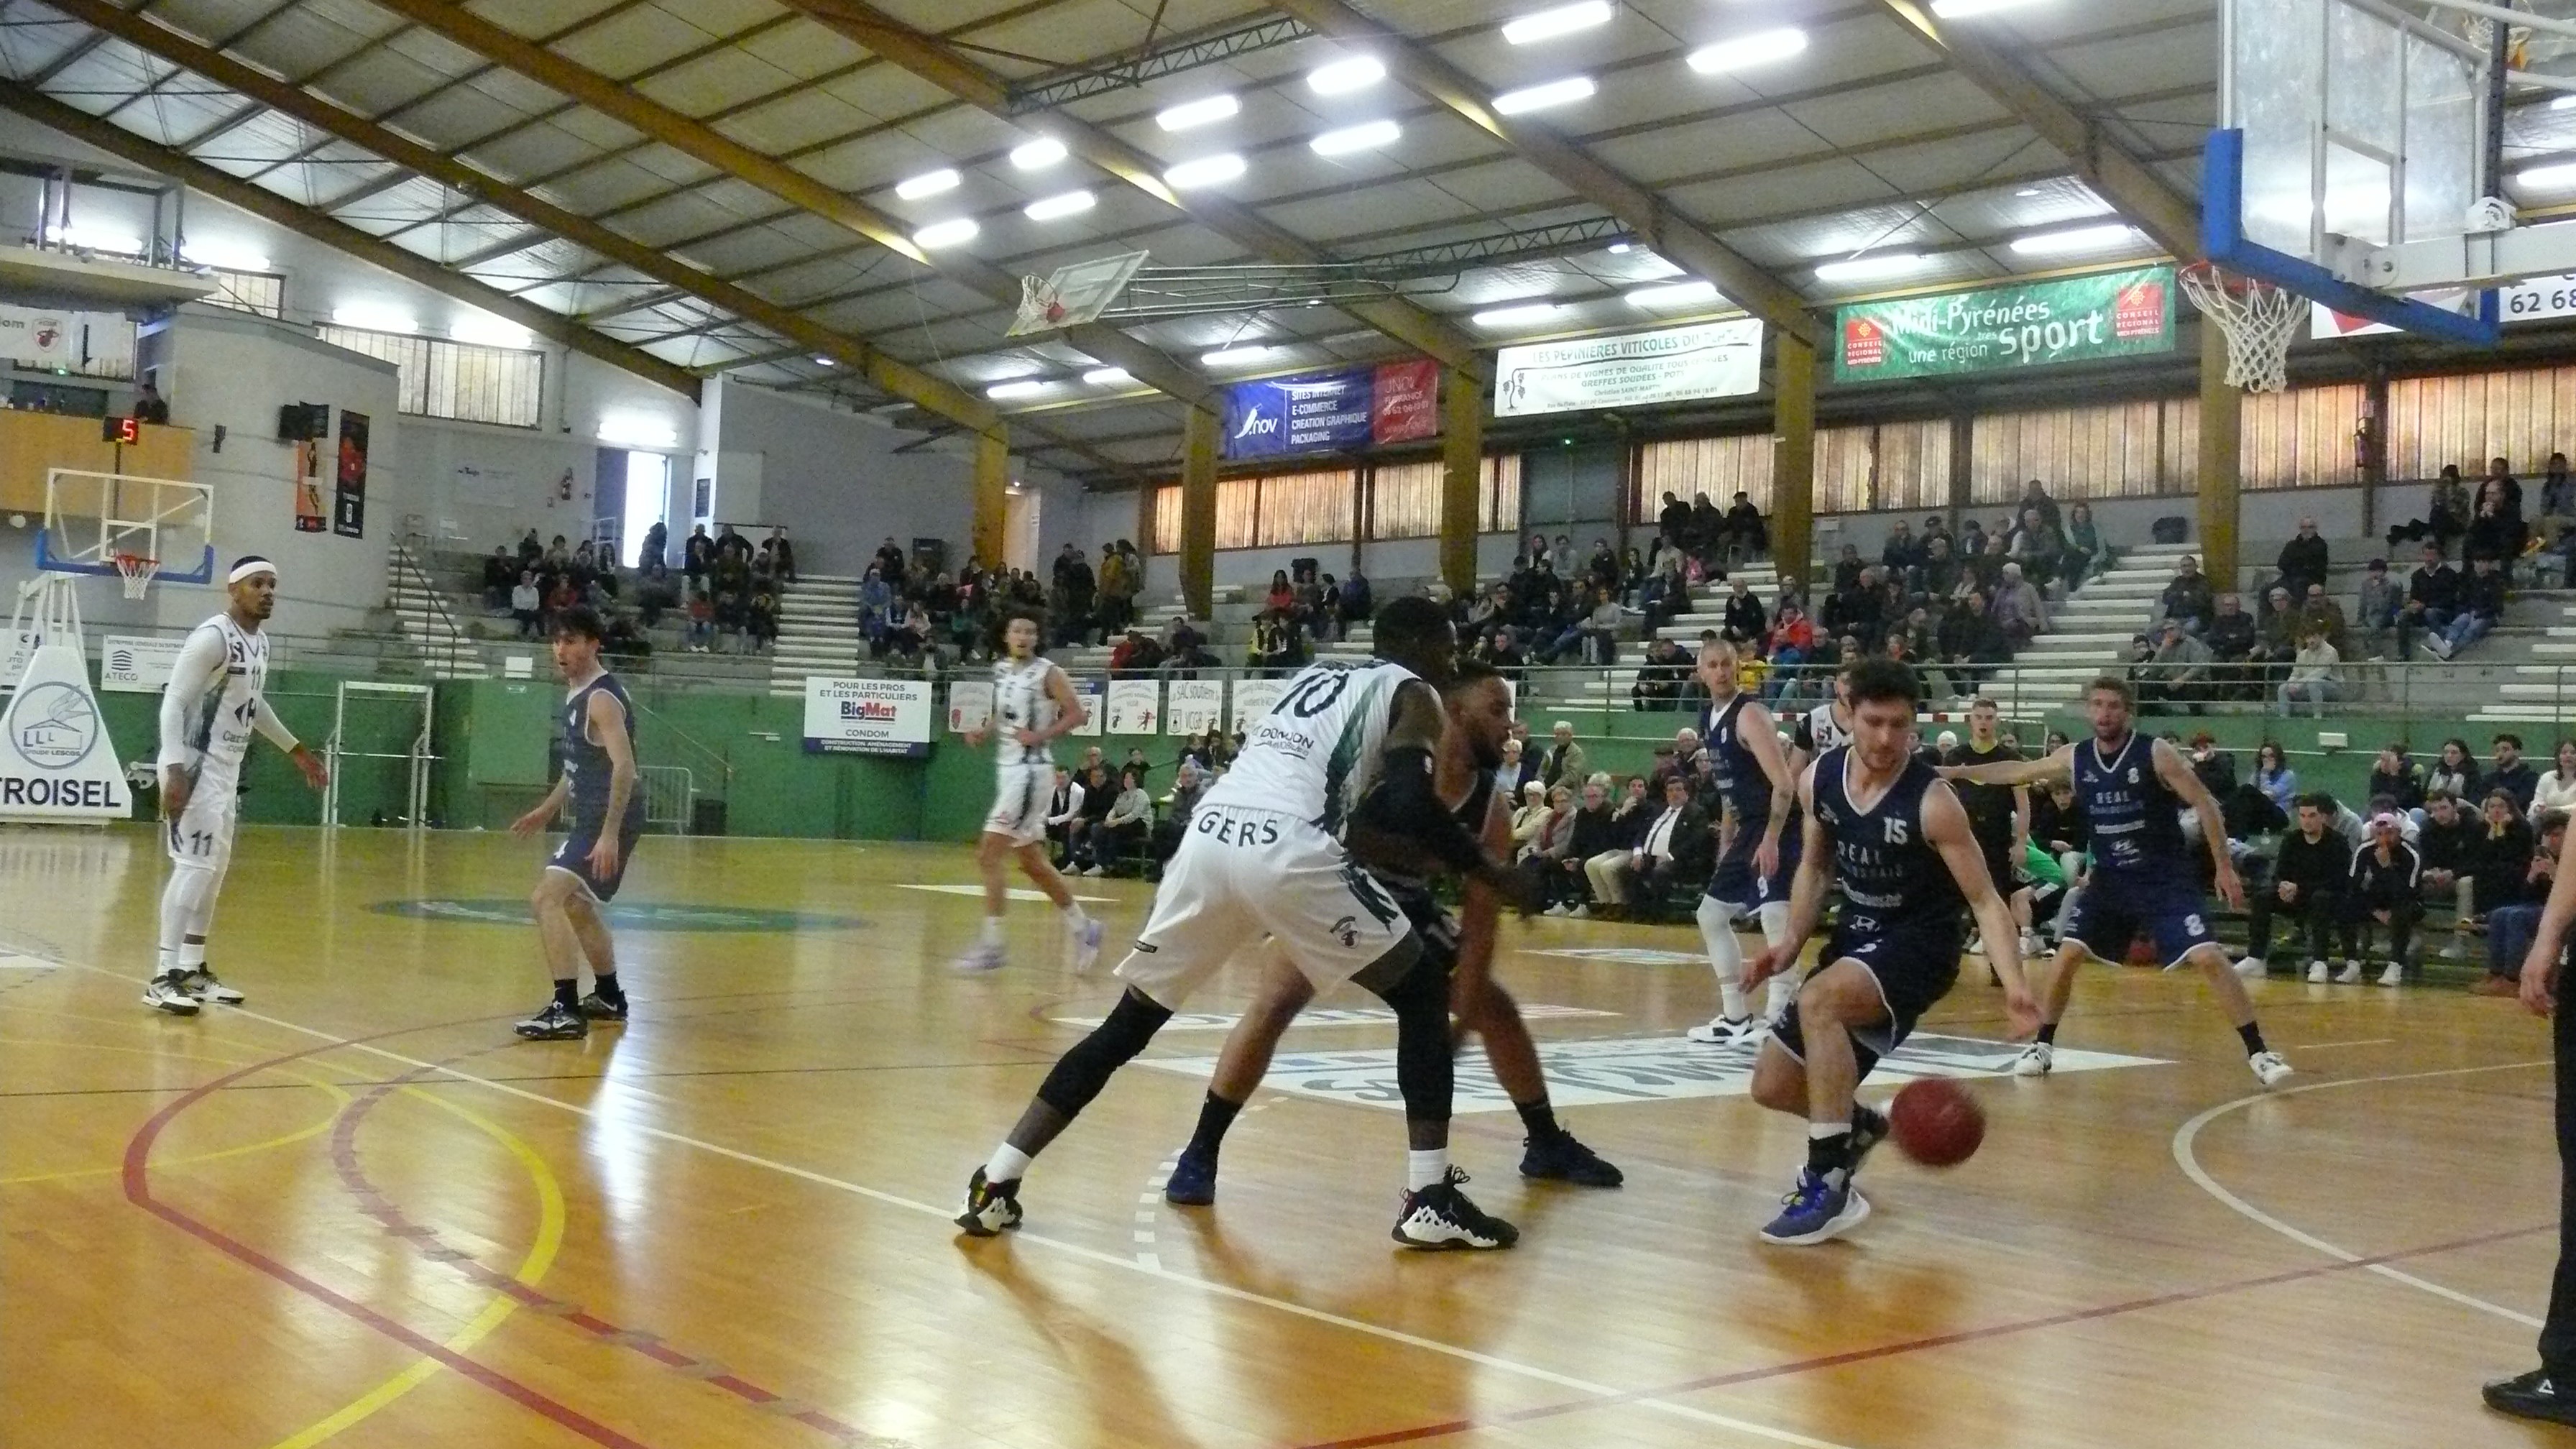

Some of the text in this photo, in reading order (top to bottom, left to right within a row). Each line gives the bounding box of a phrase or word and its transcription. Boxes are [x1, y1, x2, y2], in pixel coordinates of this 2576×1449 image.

[2511, 288, 2576, 313] 62 68
[1892, 295, 2051, 335] Midi-Pyrénées
[2117, 310, 2158, 319] CONSEIL
[1621, 337, 1678, 354] VITICOLES
[1847, 341, 1882, 349] CONSEIL
[1999, 310, 2104, 363] sport
[1909, 341, 1987, 363] une région
[1581, 377, 1619, 387] GREFFES
[1584, 369, 1613, 378] VIGNES
[1292, 390, 1311, 400] SITES
[1292, 400, 1338, 415] E-COMMERCE
[122, 419, 134, 440] 5
[1292, 412, 1367, 430] CREATION GRAPHIQUE
[1291, 431, 1330, 444] PACKAGING
[105, 672, 138, 681] ATECO
[852, 691, 917, 701] PARTICULIERS
[1271, 672, 1349, 717] 10
[841, 701, 897, 719] BigMat
[845, 729, 889, 738] CONDOM
[1261, 728, 1315, 748] DONJON
[0, 778, 121, 808] ROISEL
[1198, 811, 1278, 847] GERS
[1883, 816, 1908, 845] 15
[190, 829, 213, 857] 11
[2184, 913, 2205, 937] 8
